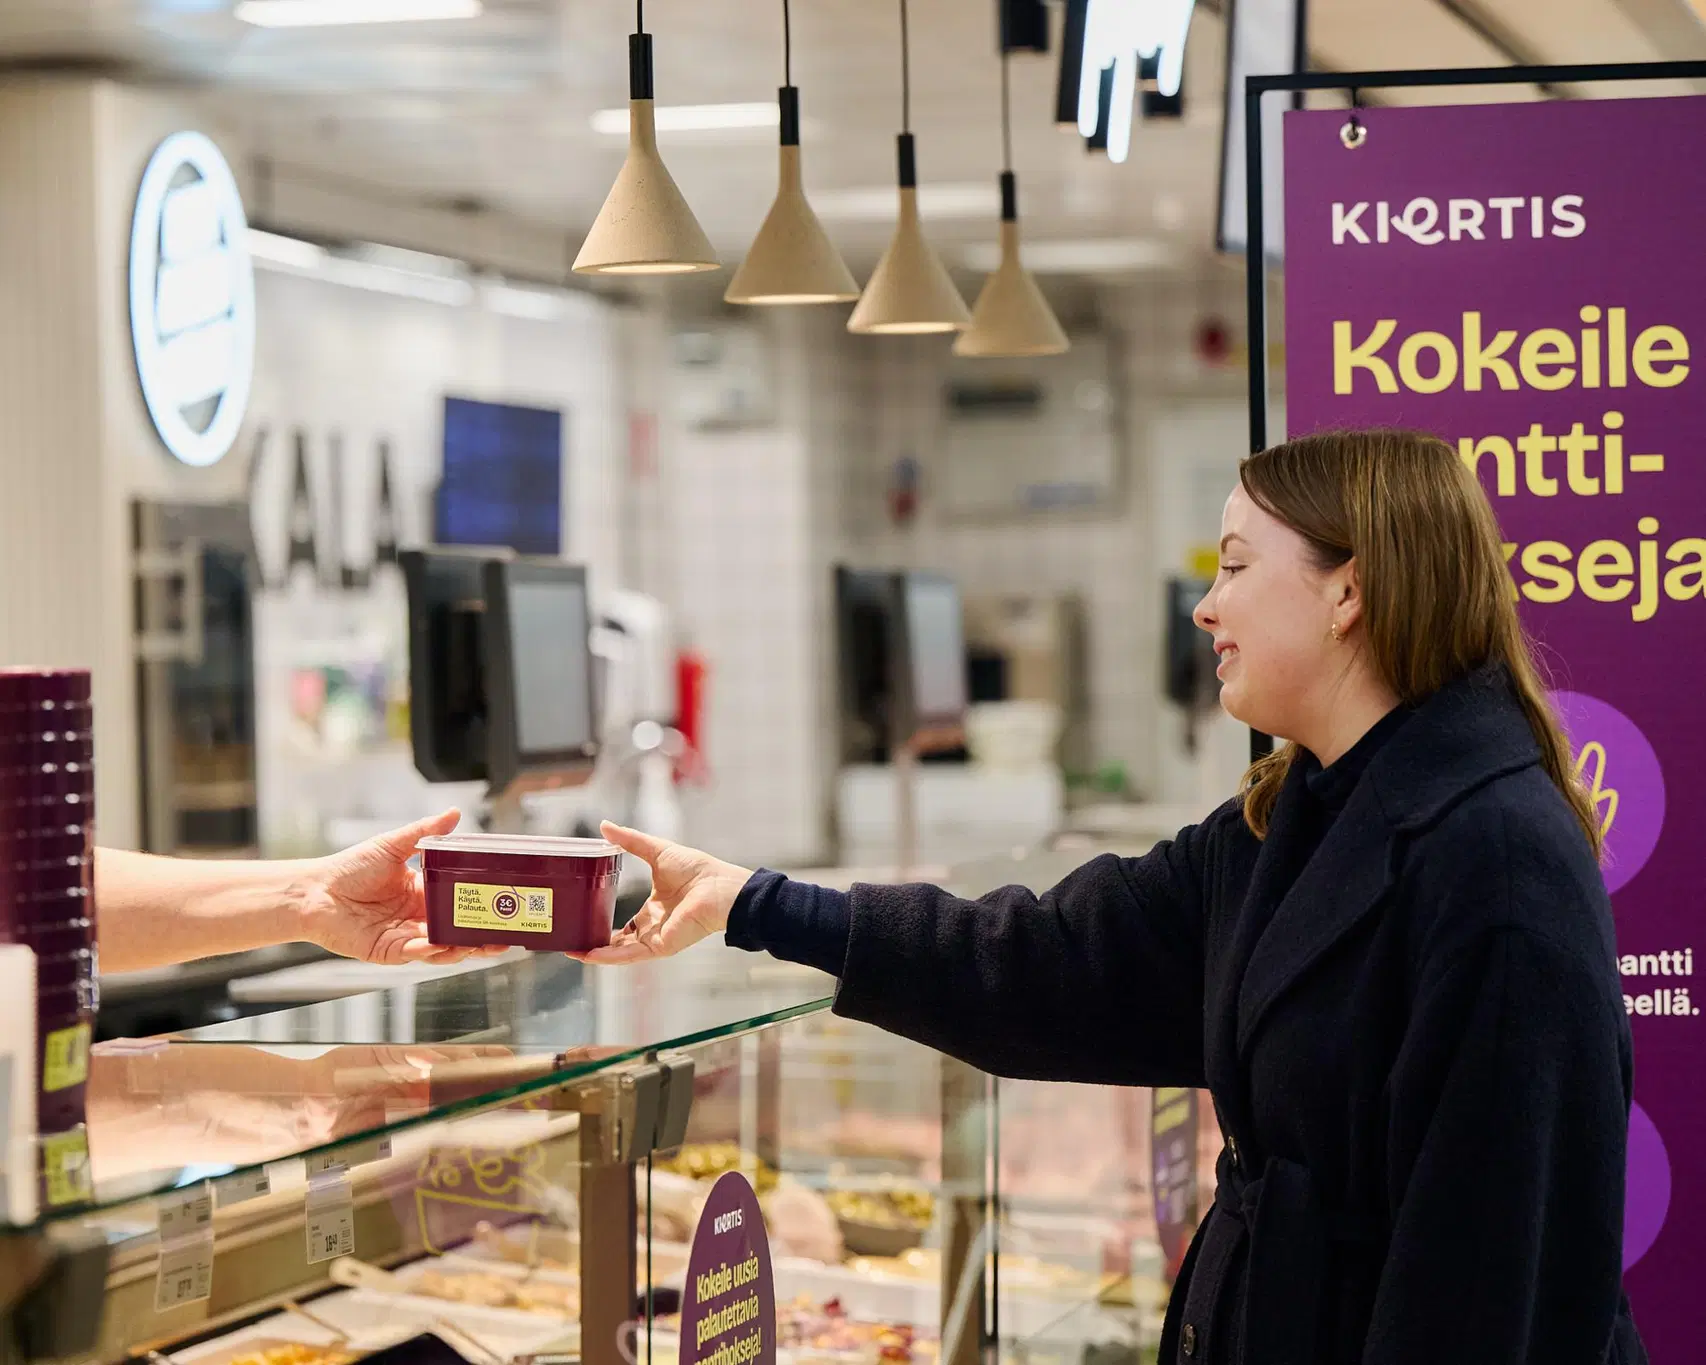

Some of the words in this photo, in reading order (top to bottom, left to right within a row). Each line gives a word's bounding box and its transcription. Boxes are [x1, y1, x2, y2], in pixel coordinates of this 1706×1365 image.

[1332, 305, 1691, 395] Kokeile
[1458, 410, 1664, 497] ntti-
[1498, 516, 1706, 622] seja
[458, 888, 481, 896] Täytä.
[458, 896, 482, 904] Käytä.
[458, 904, 488, 913] Palauta.
[1616, 947, 1693, 976] antti
[696, 1262, 732, 1304] Kokeile
[733, 1250, 759, 1286] uusia
[696, 1289, 759, 1351] palautettavia
